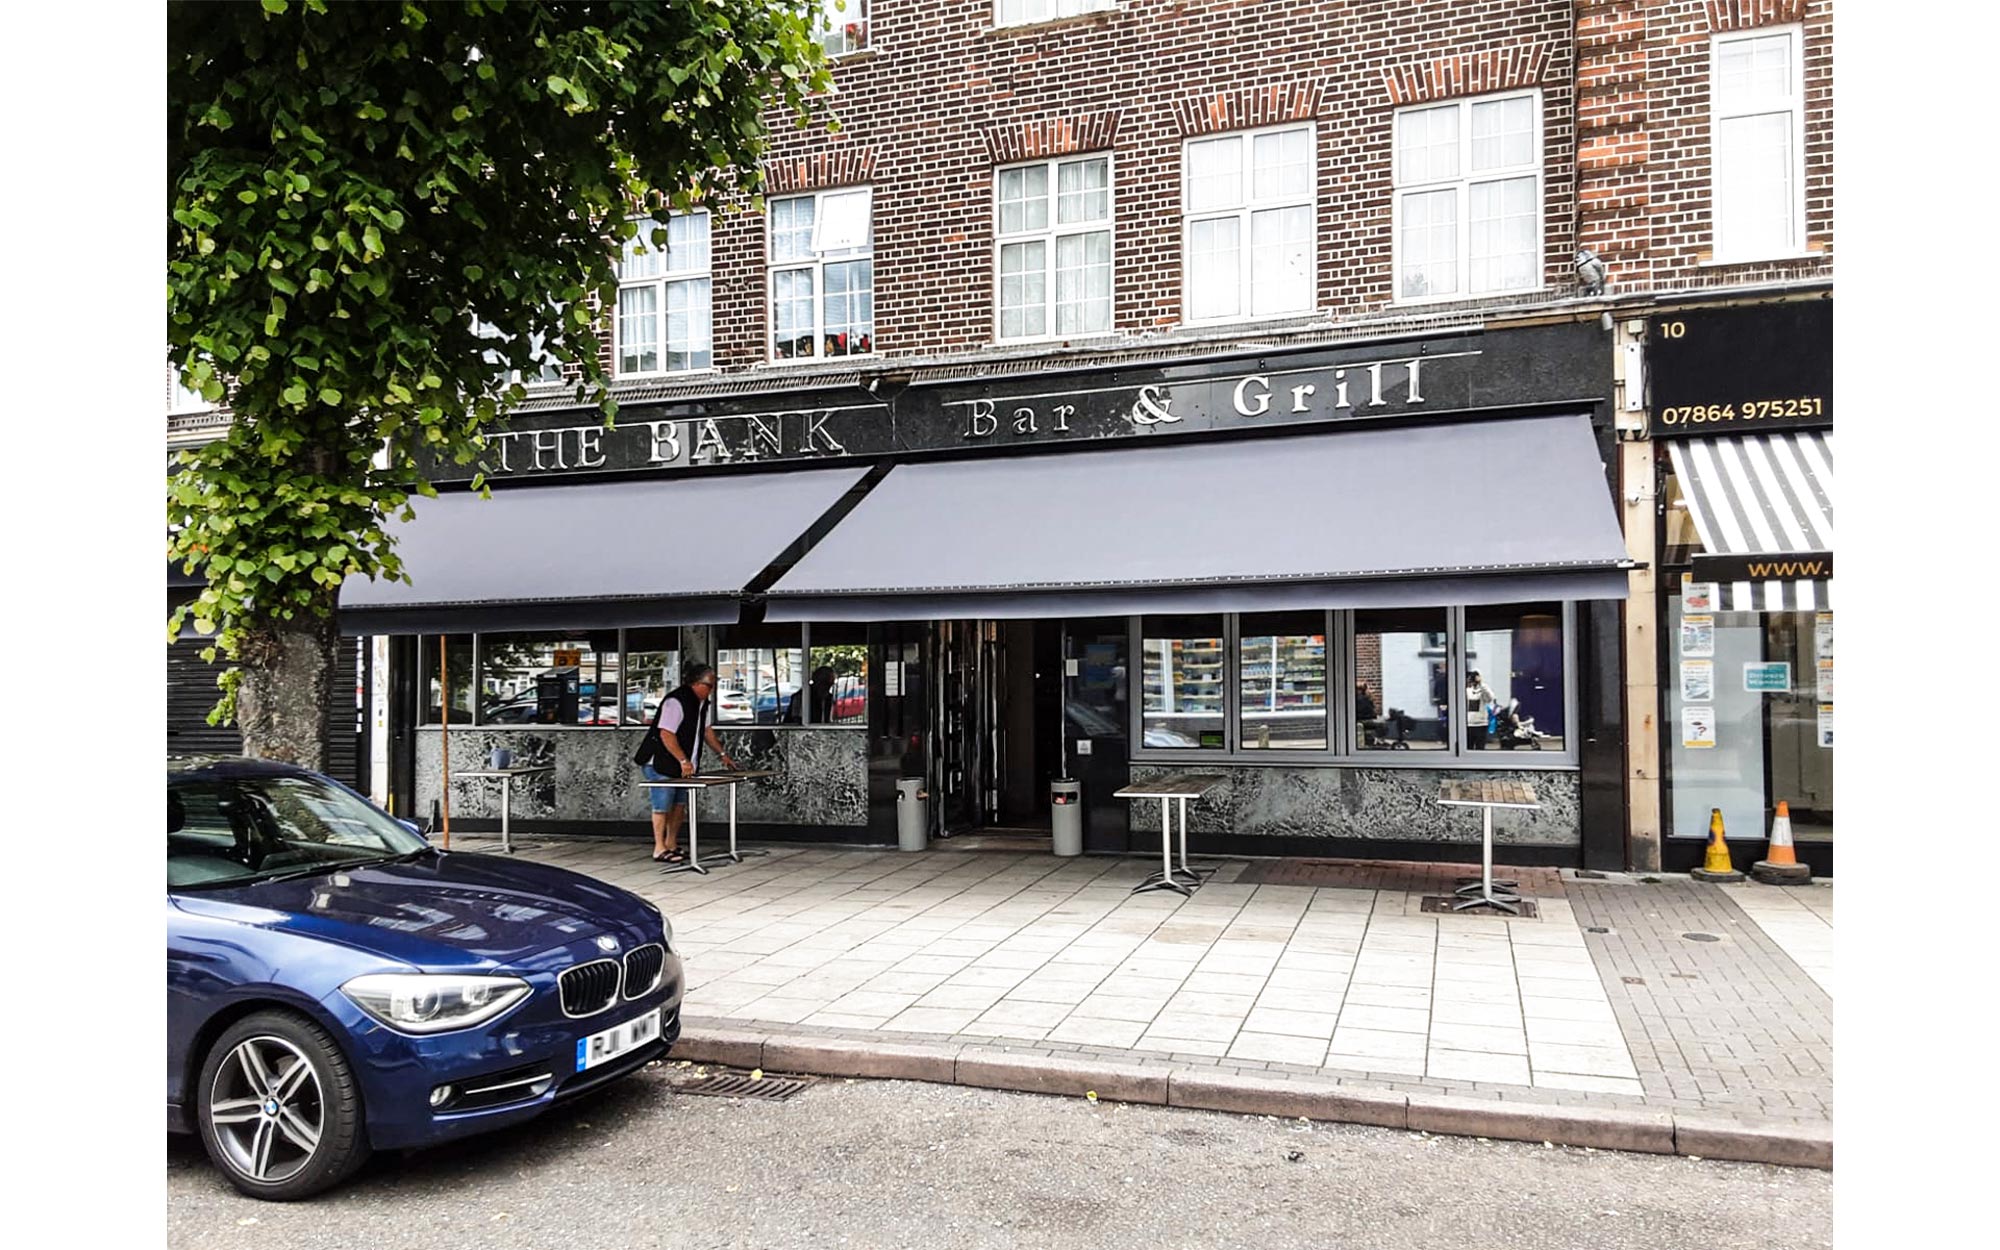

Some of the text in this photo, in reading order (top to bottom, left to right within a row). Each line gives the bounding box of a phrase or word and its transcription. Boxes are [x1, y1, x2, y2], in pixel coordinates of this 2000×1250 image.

[1661, 322, 1685, 339] 10
[487, 361, 1425, 472] THE BANK Bar & Grill
[1662, 398, 1822, 425] 07864 975251
